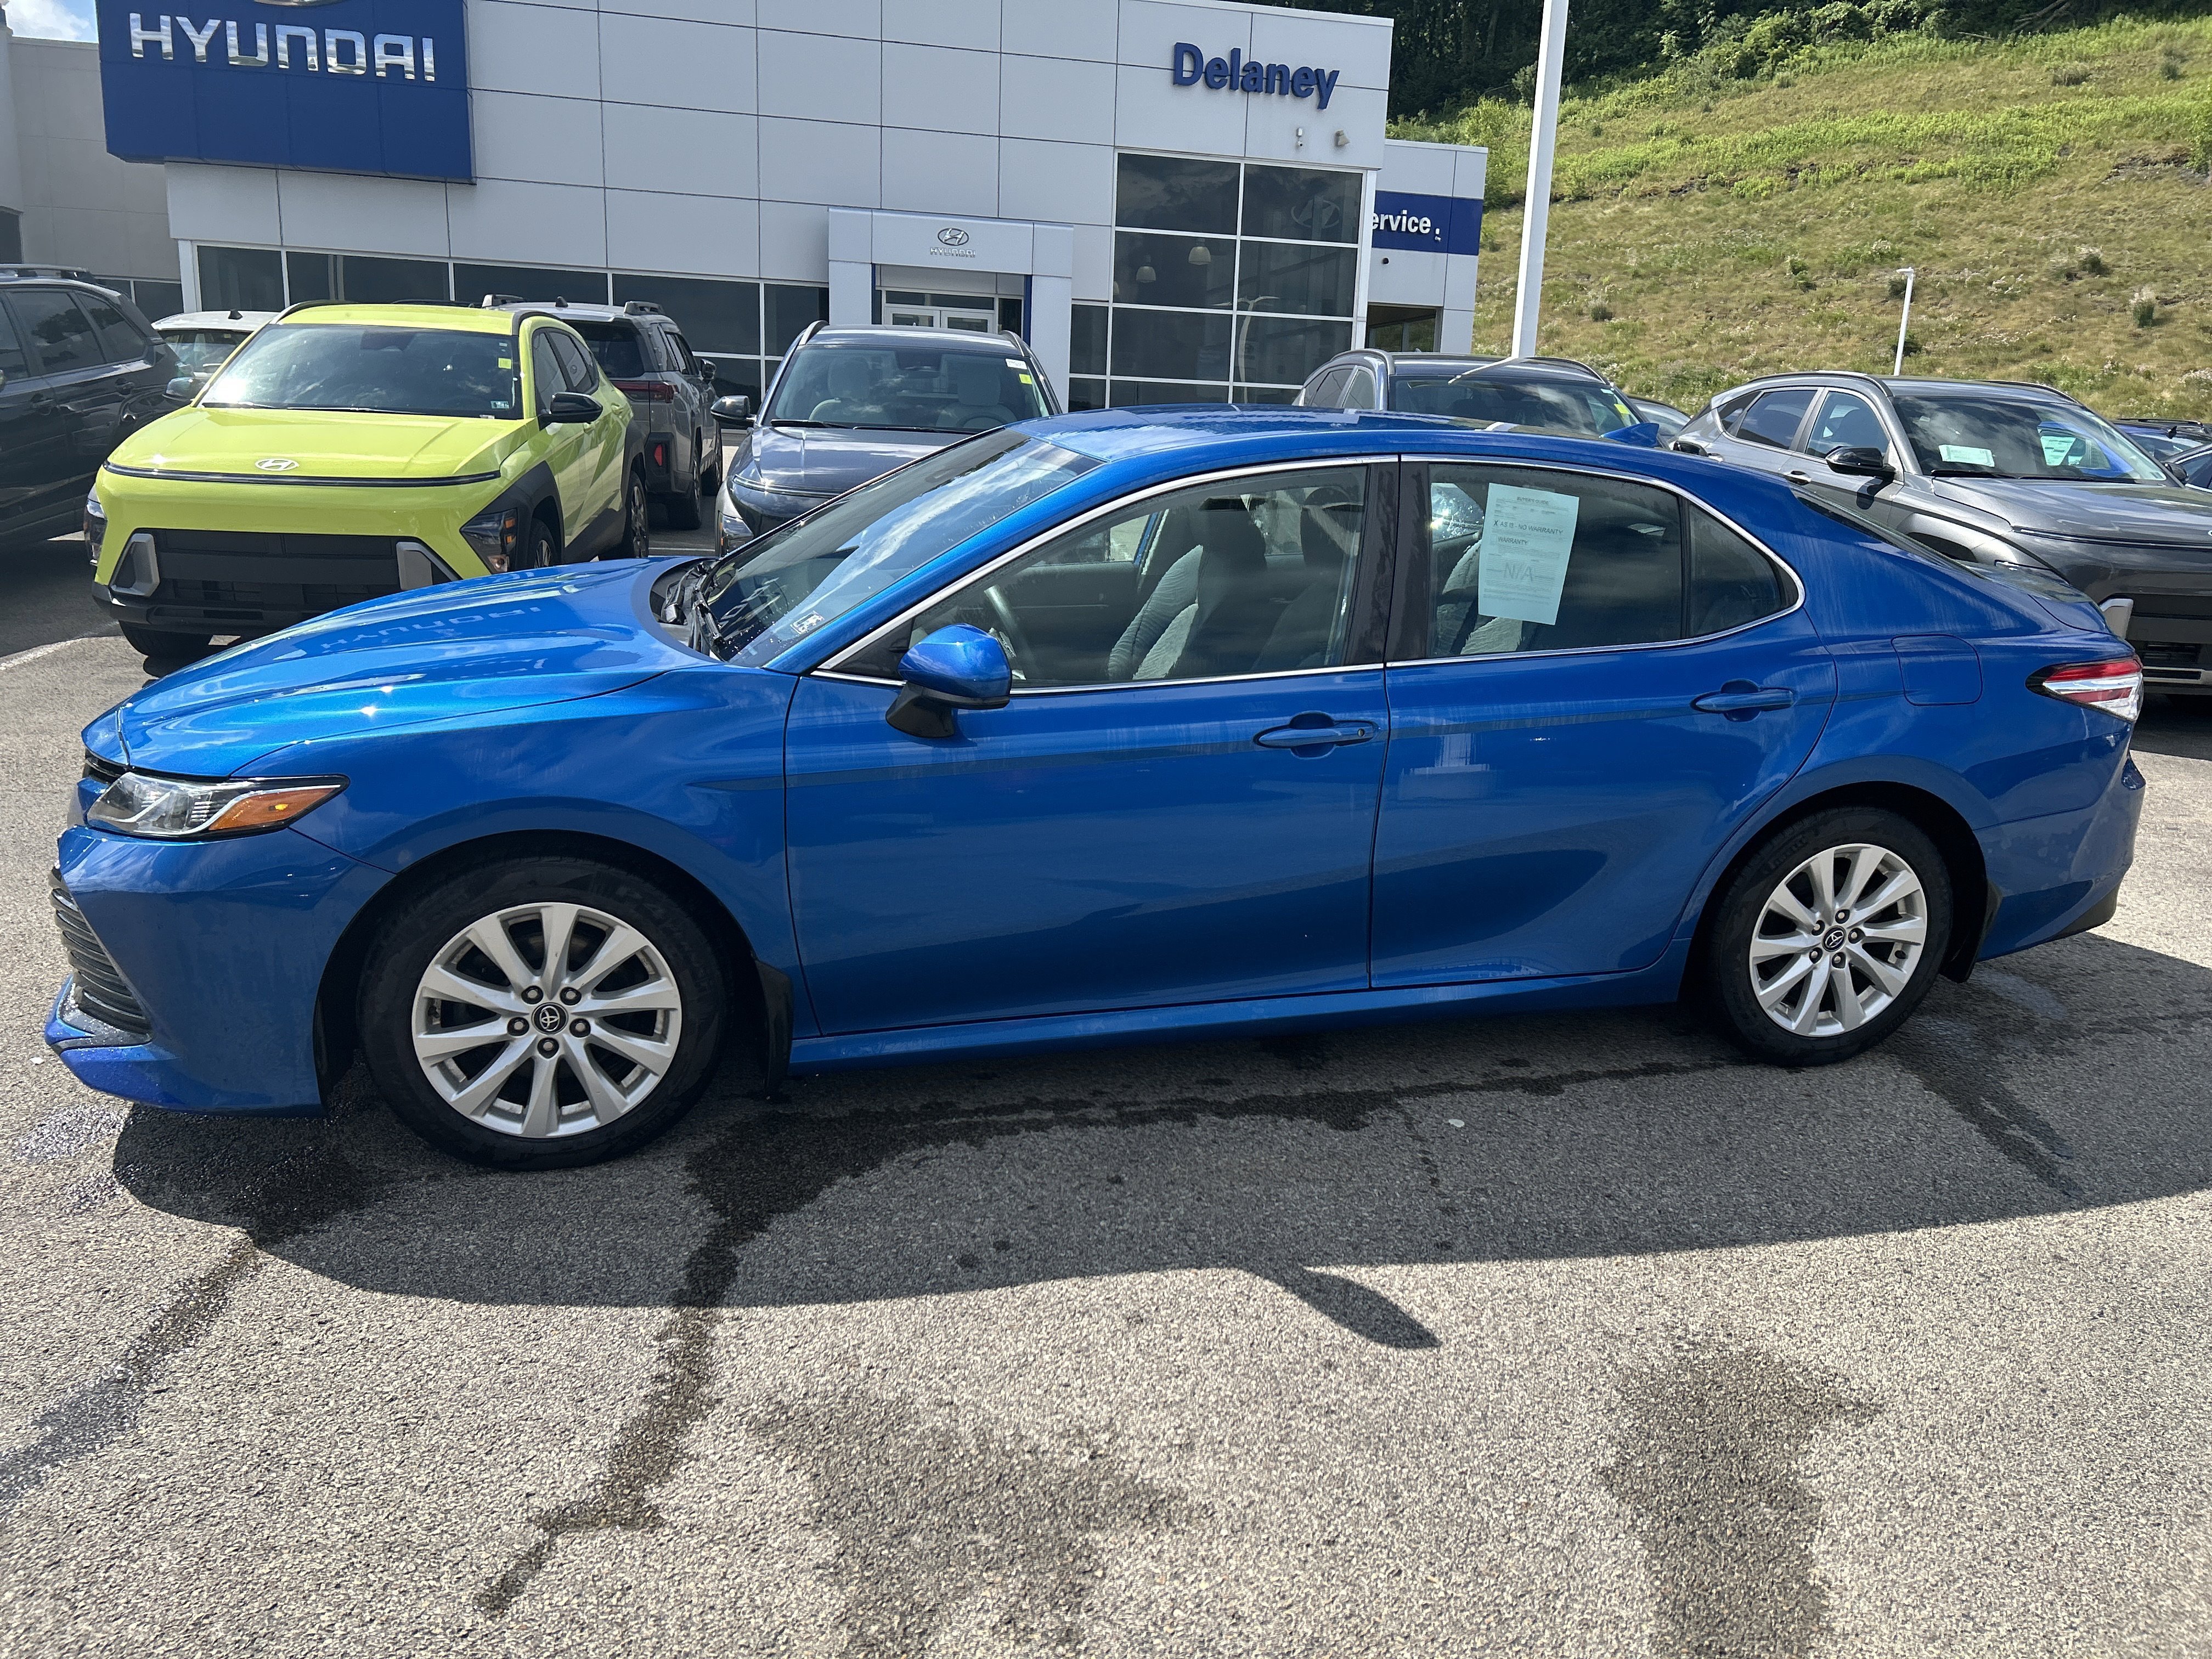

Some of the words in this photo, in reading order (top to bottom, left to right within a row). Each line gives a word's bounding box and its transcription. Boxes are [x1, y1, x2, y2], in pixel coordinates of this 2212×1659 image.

[129, 13, 435, 82] HYUNDAI
[1173, 42, 1340, 110] Delaney
[1372, 210, 1431, 234] ervice
[930, 247, 975, 258] HYUNDAI
[1528, 526, 1563, 535] WARRANTY
[1498, 537, 1528, 545] WARRANTY
